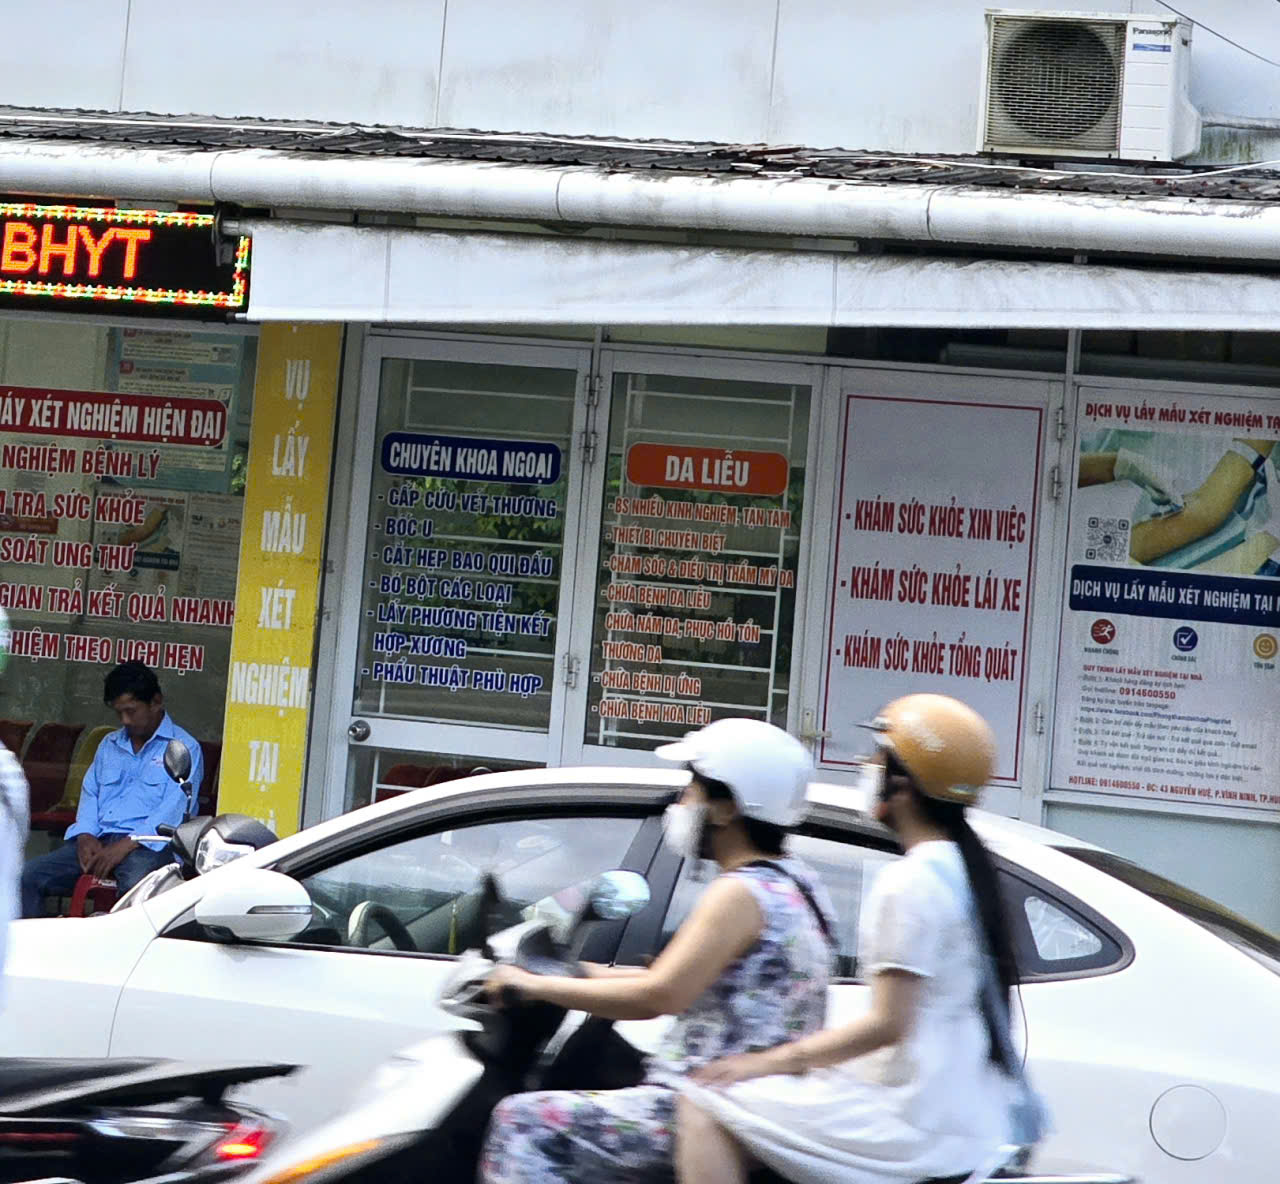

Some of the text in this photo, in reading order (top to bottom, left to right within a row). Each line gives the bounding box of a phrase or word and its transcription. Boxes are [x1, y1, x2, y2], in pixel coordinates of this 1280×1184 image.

[1, 222, 151, 280] BHYT
[285, 359, 311, 409] VỤ
[28, 394, 63, 429] XÉT
[69, 401, 138, 439] NGHIỆM
[143, 404, 185, 442] HIỆN
[191, 408, 221, 445] ĐẠI
[138, 448, 160, 478] LÝ
[390, 439, 553, 483] CHUYÊN KHOA NGOẠI
[665, 456, 694, 482] DA
[12, 491, 46, 516] TRA
[855, 494, 894, 533] KHÁM
[897, 497, 925, 535] SỨC
[968, 508, 993, 540] XIN
[0, 535, 48, 565] SOÁT
[53, 544, 93, 568] UNG
[99, 543, 137, 573] THƯ
[452, 552, 482, 570] BAO
[258, 576, 295, 629] XÉT
[851, 561, 894, 600] KHÁM
[898, 564, 928, 604] SỨC
[974, 569, 999, 609] LÁI
[1002, 578, 1022, 611] XE
[1073, 579, 1100, 598] DỊCH
[66, 634, 204, 676] THEO HẸN
[844, 629, 881, 668] KHÁM
[883, 632, 910, 672] SỨC
